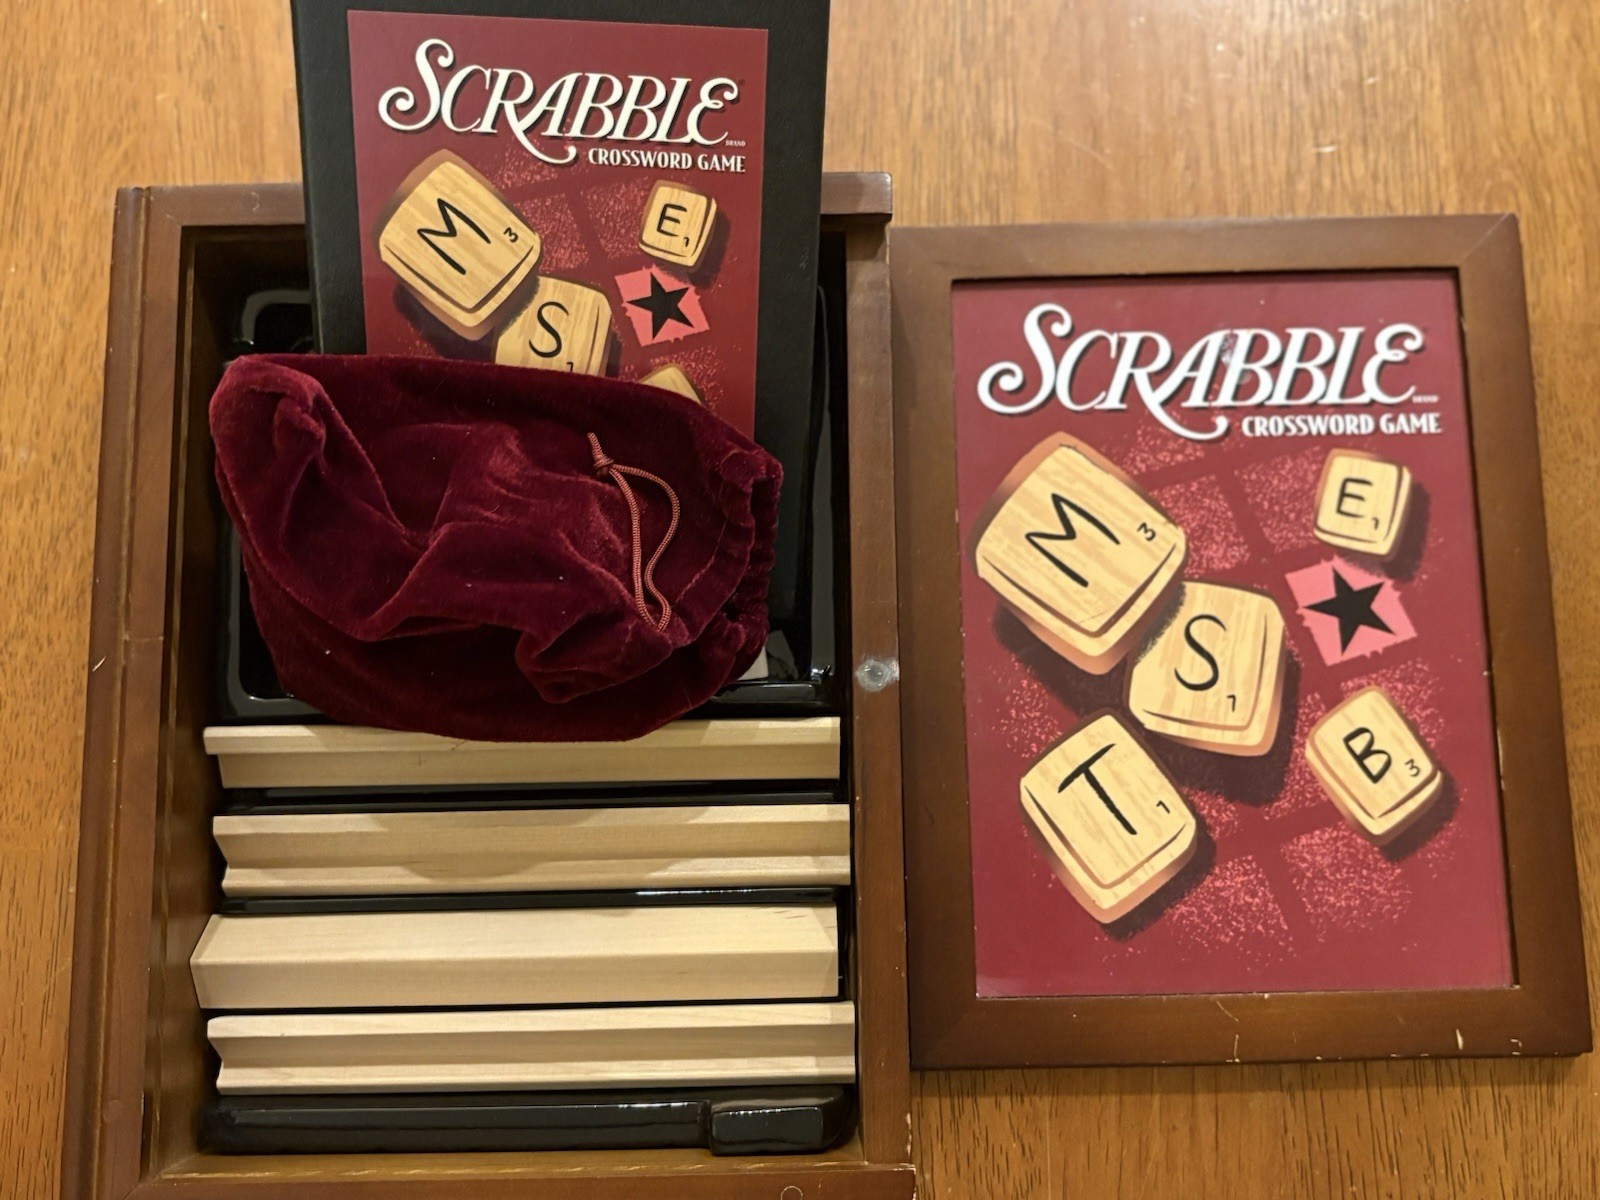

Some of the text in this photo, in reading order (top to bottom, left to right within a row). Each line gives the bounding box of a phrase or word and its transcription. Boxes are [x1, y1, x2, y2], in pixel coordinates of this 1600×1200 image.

[378, 38, 739, 164] SCRABBLE
[588, 147, 746, 173] CROSSWORD GAME
[417, 198, 491, 275] M
[503, 227, 518, 243] 3
[657, 203, 687, 237] E
[529, 301, 569, 358] S
[977, 303, 1424, 440] SCRABBLE
[1241, 412, 1442, 437] CROSSWORD GAME
[1335, 478, 1373, 518] E
[1025, 493, 1121, 588] M
[1137, 522, 1157, 541] 3
[1174, 614, 1227, 692] S
[1343, 727, 1393, 783] B
[1404, 758, 1422, 777] 3
[1056, 743, 1137, 836] T
